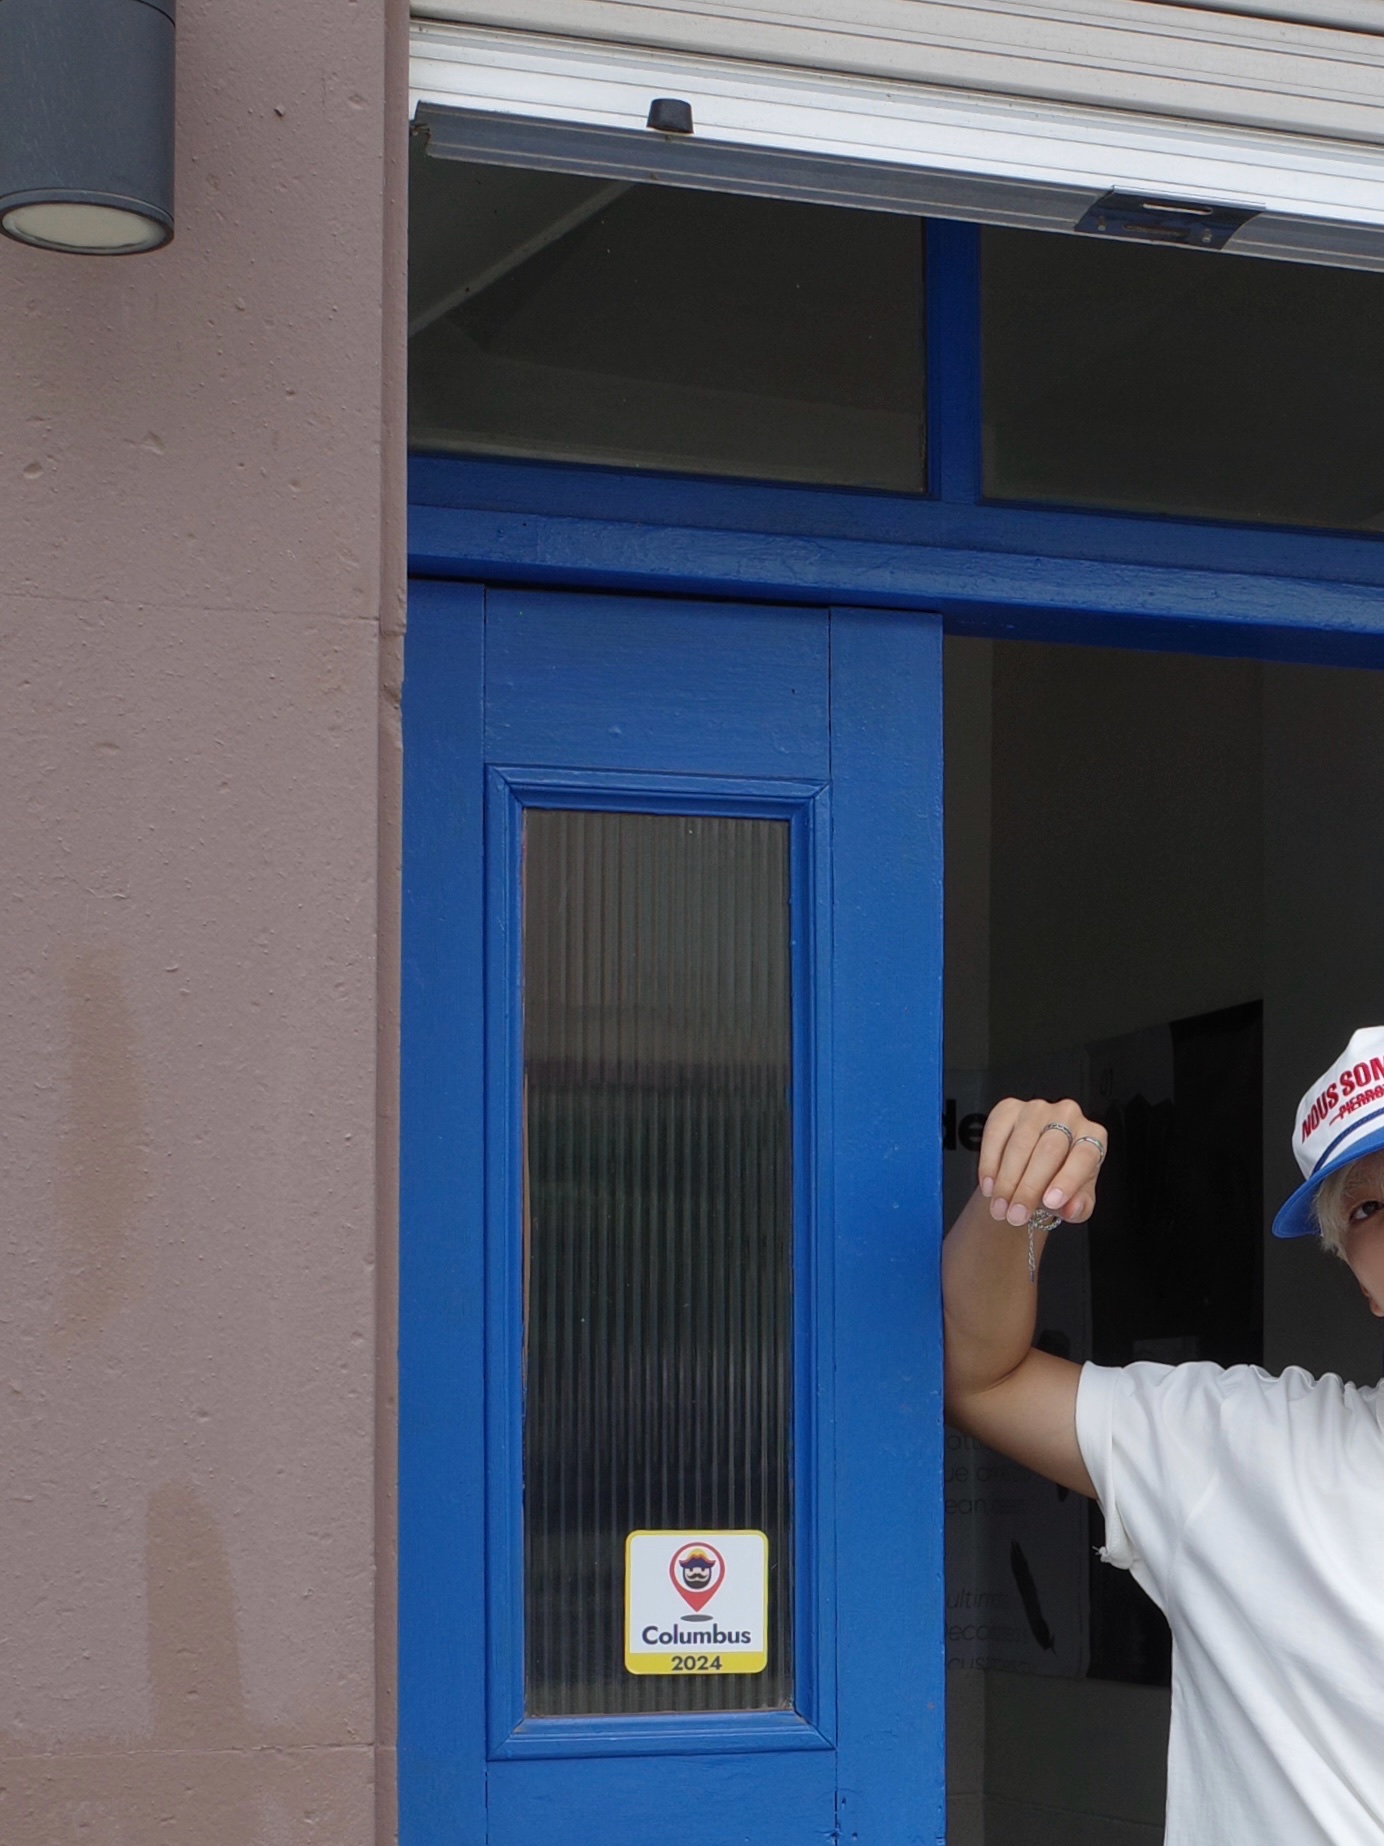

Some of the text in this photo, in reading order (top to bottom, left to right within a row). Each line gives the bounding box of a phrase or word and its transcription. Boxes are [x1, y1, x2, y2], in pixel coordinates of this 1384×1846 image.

[1301, 1082, 1339, 1144] NOUS
[642, 1623, 752, 1645] Columbus
[671, 1655, 723, 1671] 2024
